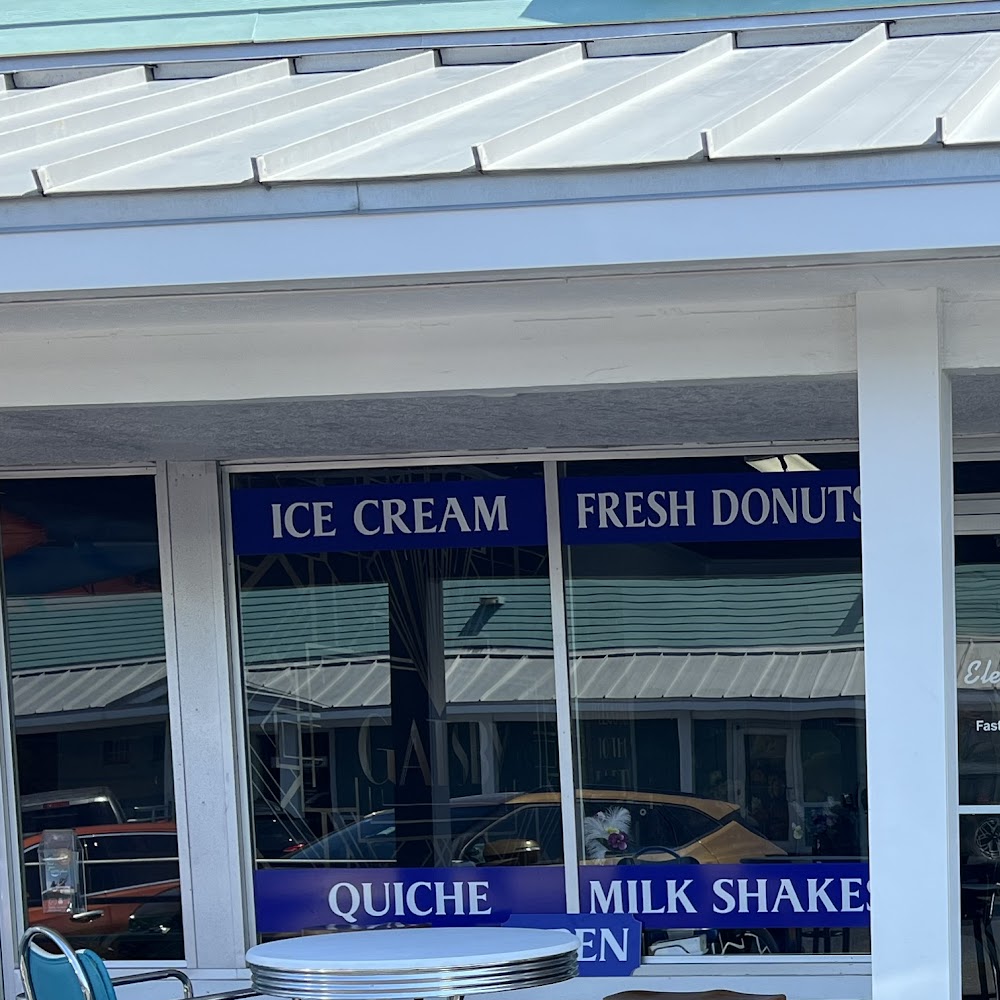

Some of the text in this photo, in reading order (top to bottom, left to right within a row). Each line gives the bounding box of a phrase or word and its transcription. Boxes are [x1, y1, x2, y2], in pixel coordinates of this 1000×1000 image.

[271, 495, 509, 538] ICE CREAM
[577, 490, 696, 529] FRESH
[328, 881, 492, 923] QUICHE
[589, 878, 871, 914] MILK SHAKE
